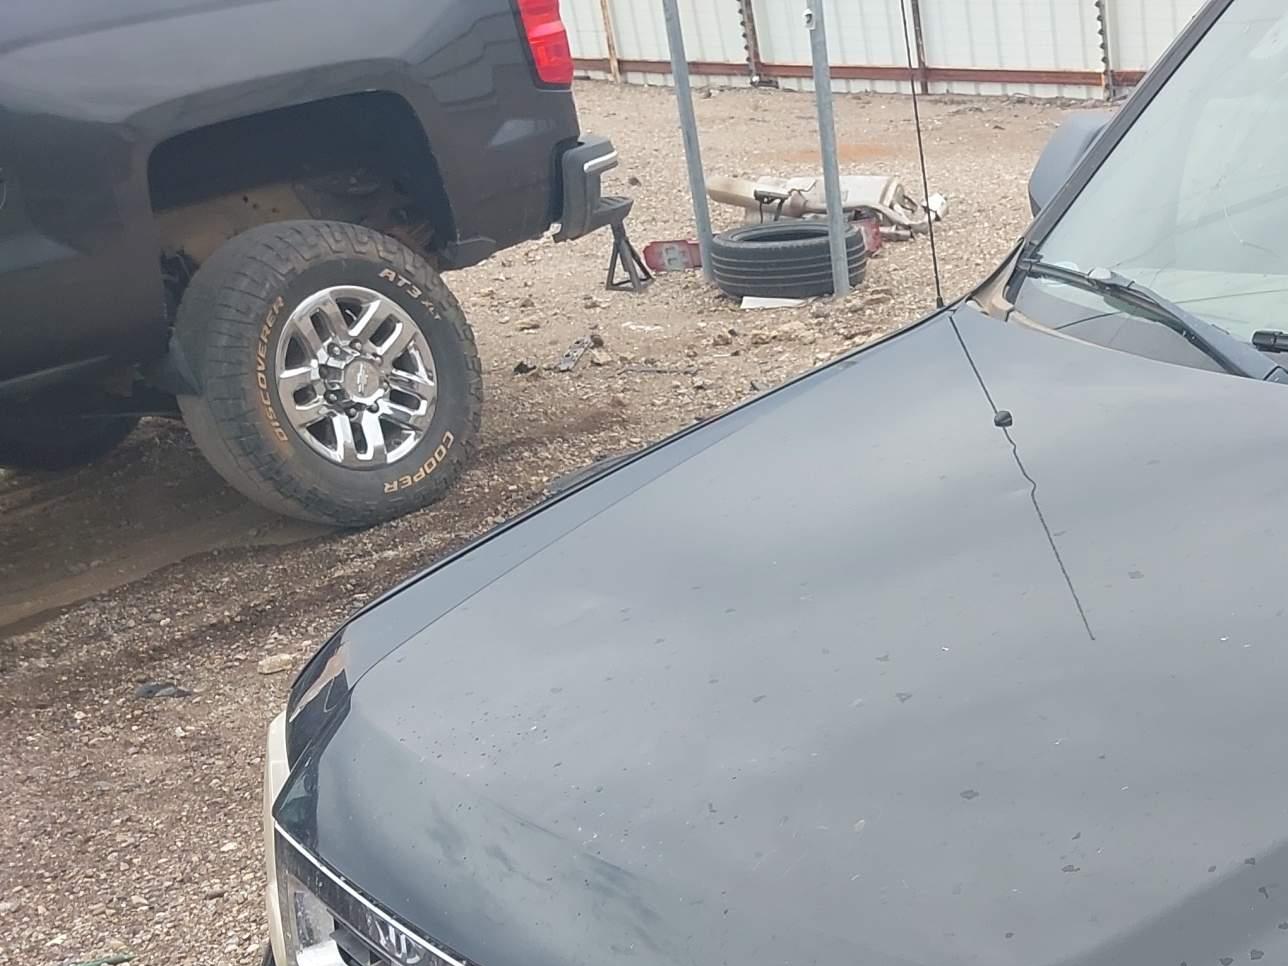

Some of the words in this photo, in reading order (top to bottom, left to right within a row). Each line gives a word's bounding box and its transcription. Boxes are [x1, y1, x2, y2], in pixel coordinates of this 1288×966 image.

[379, 268, 423, 299] AT3
[256, 295, 289, 442] DISCOVERER
[384, 431, 455, 494] COOPER
